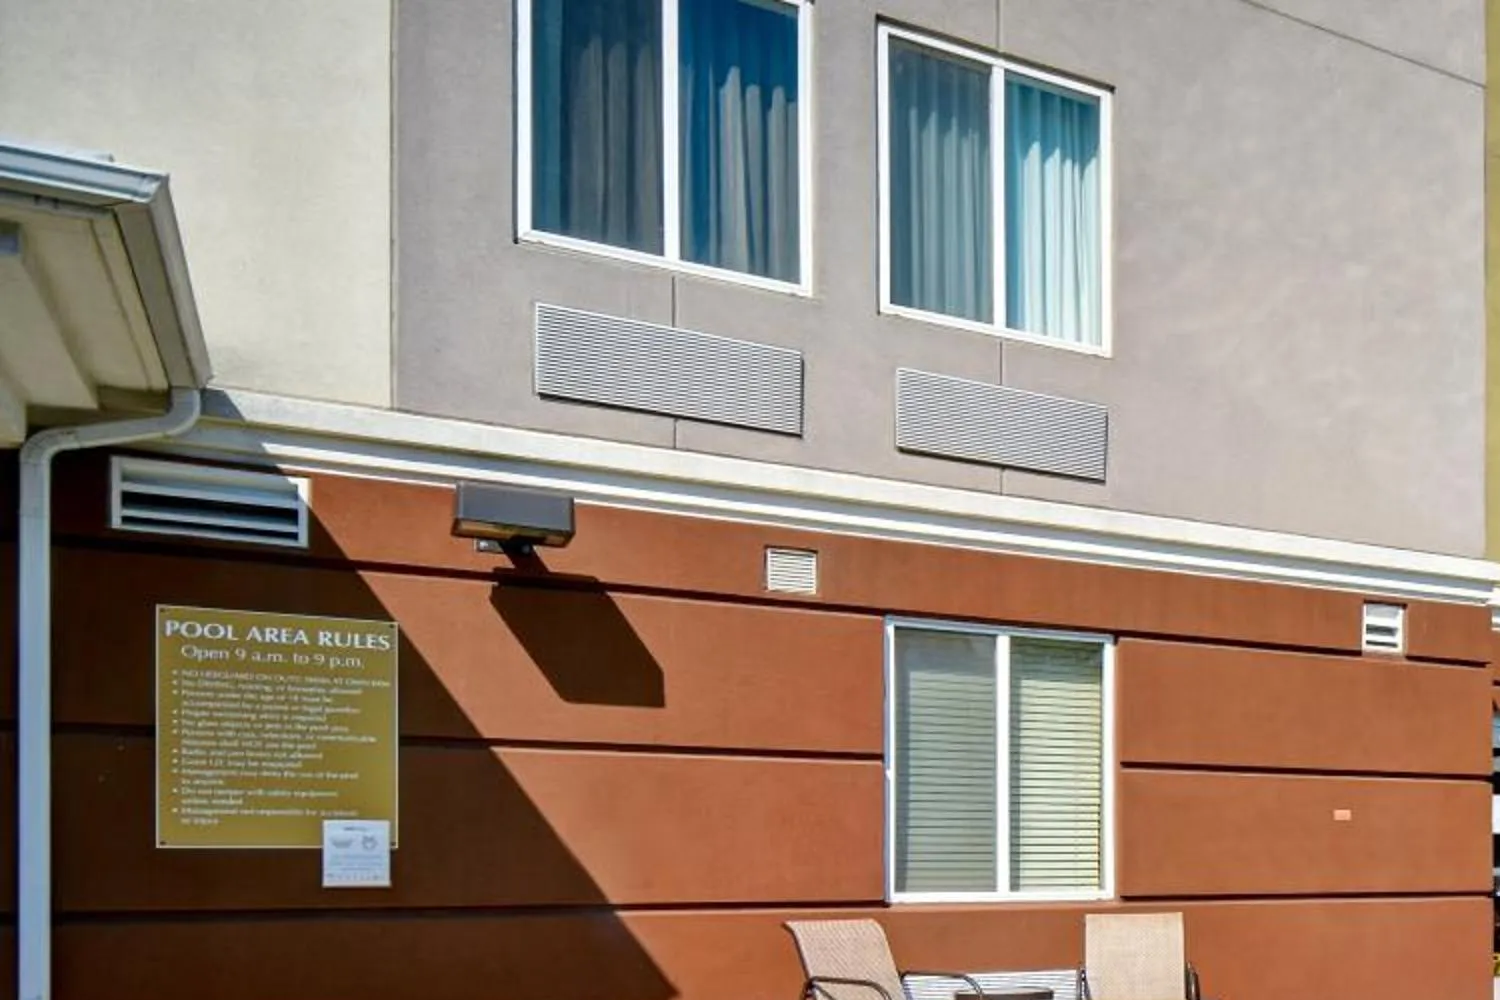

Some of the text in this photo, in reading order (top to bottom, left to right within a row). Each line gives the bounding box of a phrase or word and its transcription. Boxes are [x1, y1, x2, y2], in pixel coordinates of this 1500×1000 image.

[165, 620, 391, 650] POOL AREA RULES
[181, 644, 230, 662] Open
[235, 648, 247, 661] 9
[293, 653, 310, 665] to
[312, 654, 325, 667] 9
